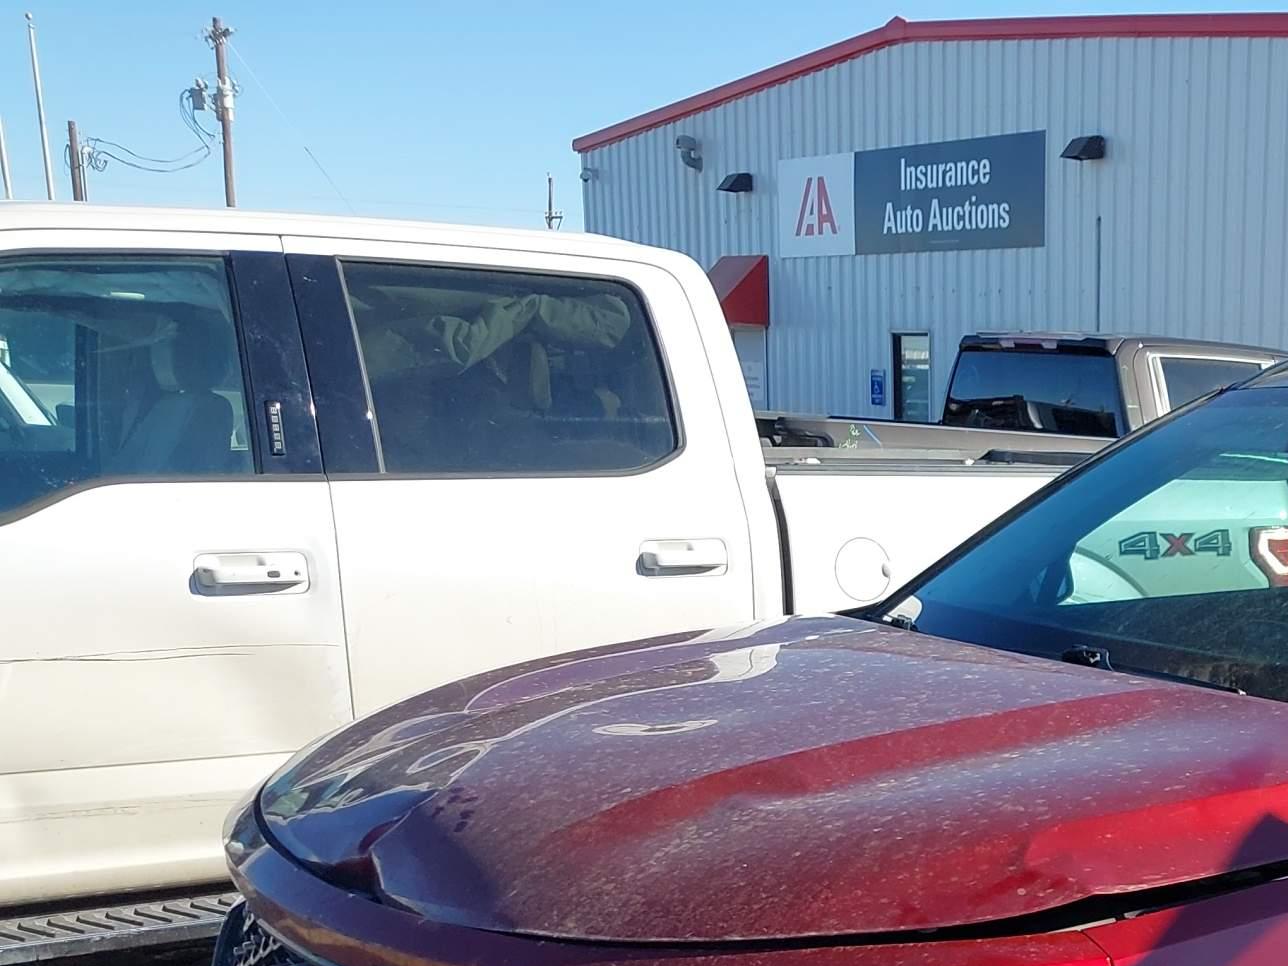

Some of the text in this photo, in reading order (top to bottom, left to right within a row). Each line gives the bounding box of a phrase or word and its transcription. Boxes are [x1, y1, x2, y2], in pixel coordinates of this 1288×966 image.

[900, 158, 991, 191] Insurance
[883, 196, 1010, 235] Auto Auctions
